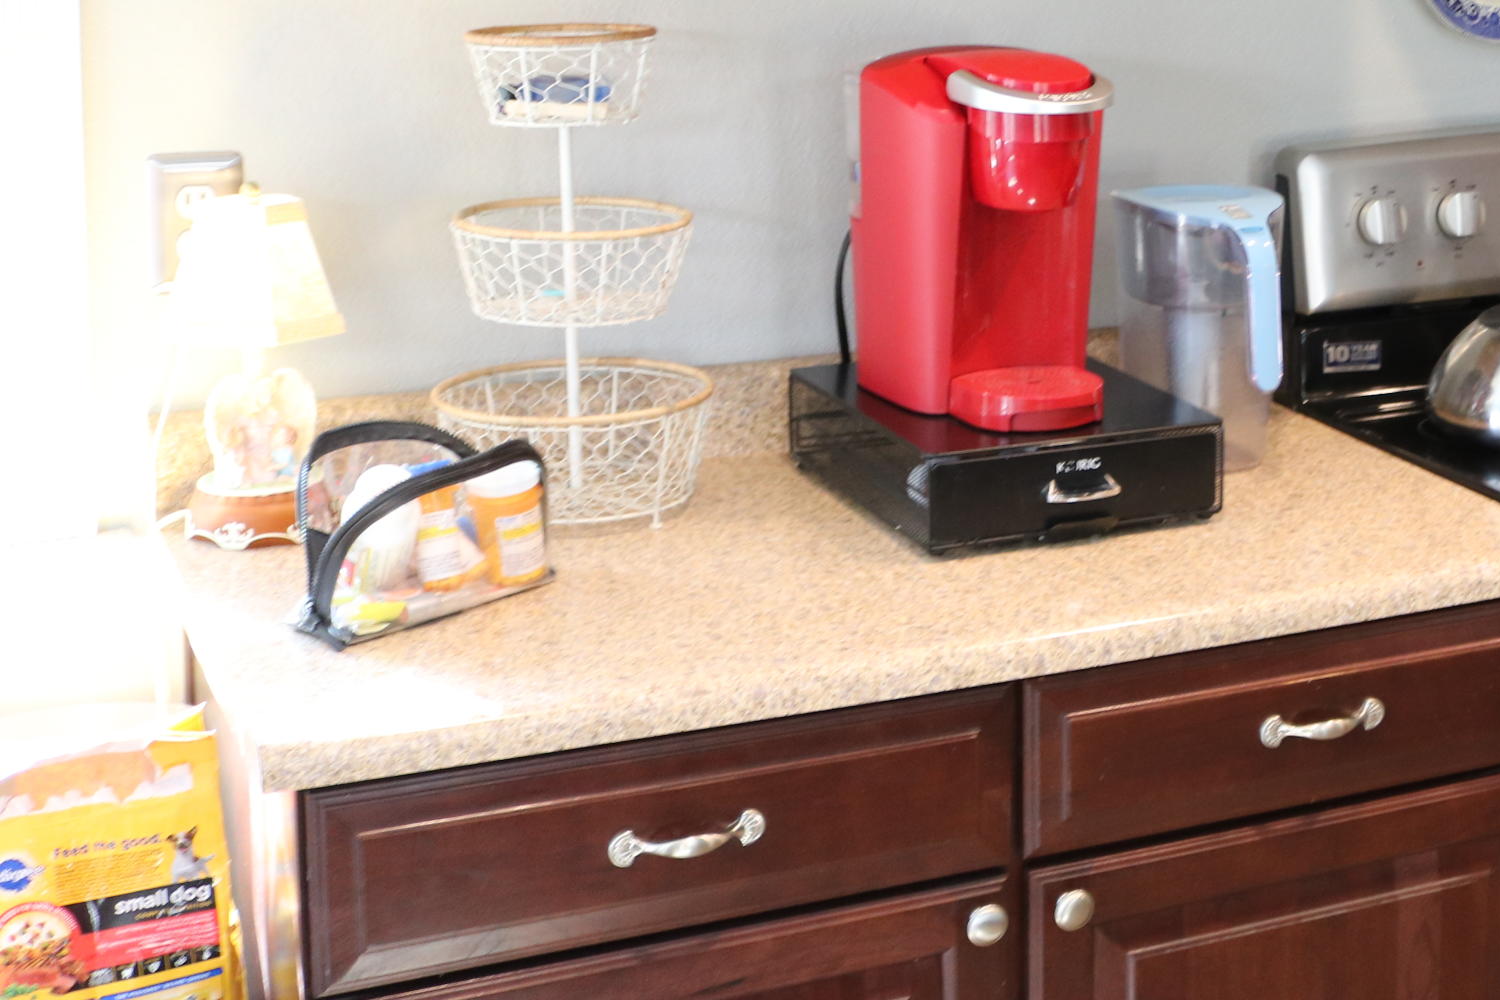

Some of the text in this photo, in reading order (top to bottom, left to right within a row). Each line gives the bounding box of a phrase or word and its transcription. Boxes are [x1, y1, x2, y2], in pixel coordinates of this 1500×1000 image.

[1327, 345, 1350, 363] 10
[113, 889, 168, 916] small
[169, 883, 212, 905] dog
